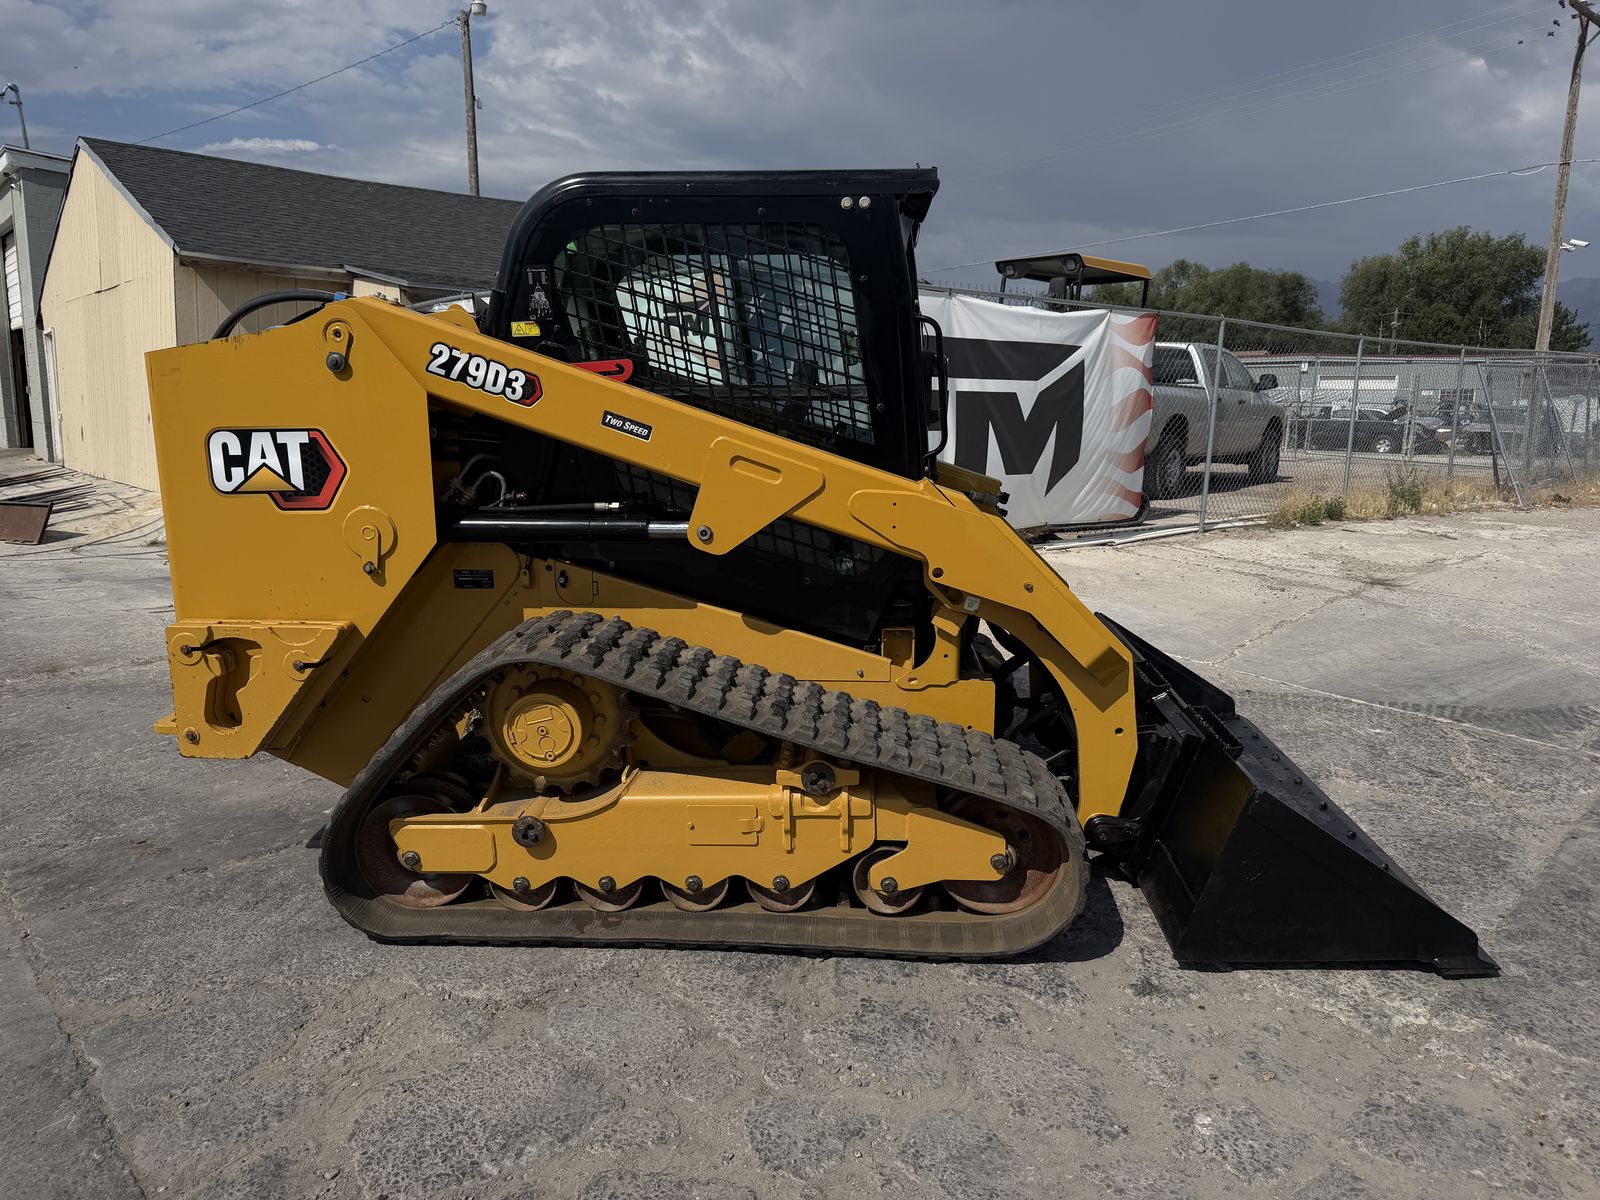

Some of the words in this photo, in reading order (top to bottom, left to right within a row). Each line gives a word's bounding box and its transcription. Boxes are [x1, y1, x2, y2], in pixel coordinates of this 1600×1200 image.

[428, 343, 526, 401] 279D3
[623, 421, 649, 436] SPEED
[209, 430, 310, 492] CAT
